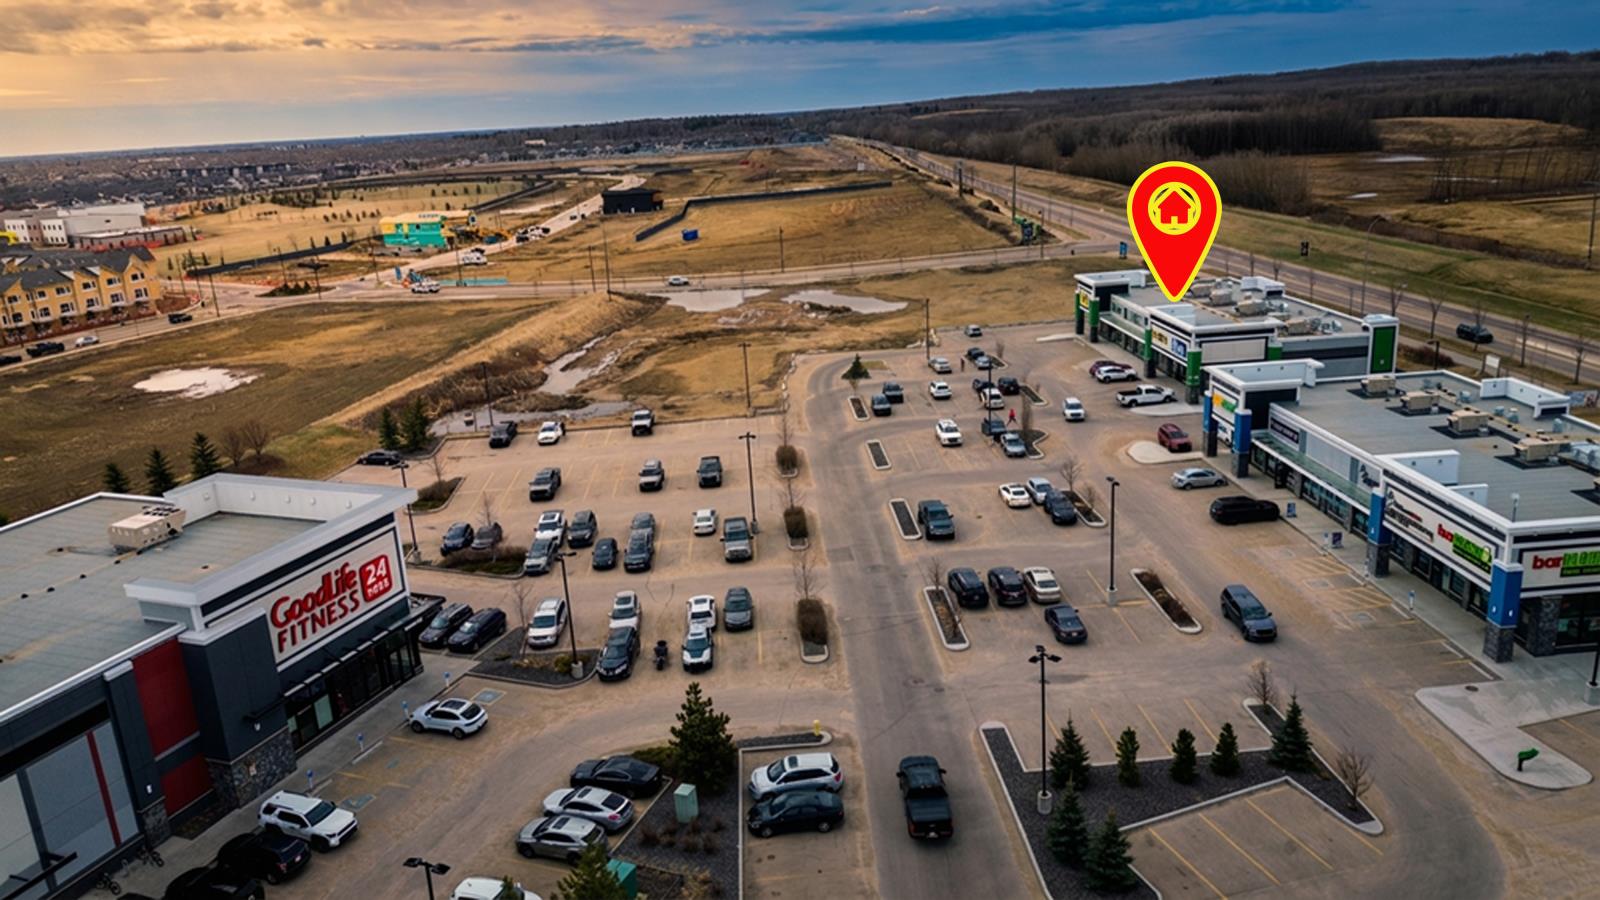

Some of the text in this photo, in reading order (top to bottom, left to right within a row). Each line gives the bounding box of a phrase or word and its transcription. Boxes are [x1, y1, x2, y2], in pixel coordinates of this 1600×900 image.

[271, 562, 358, 628] GoodLife
[365, 557, 387, 585] 24
[277, 590, 360, 654] FITNESS
